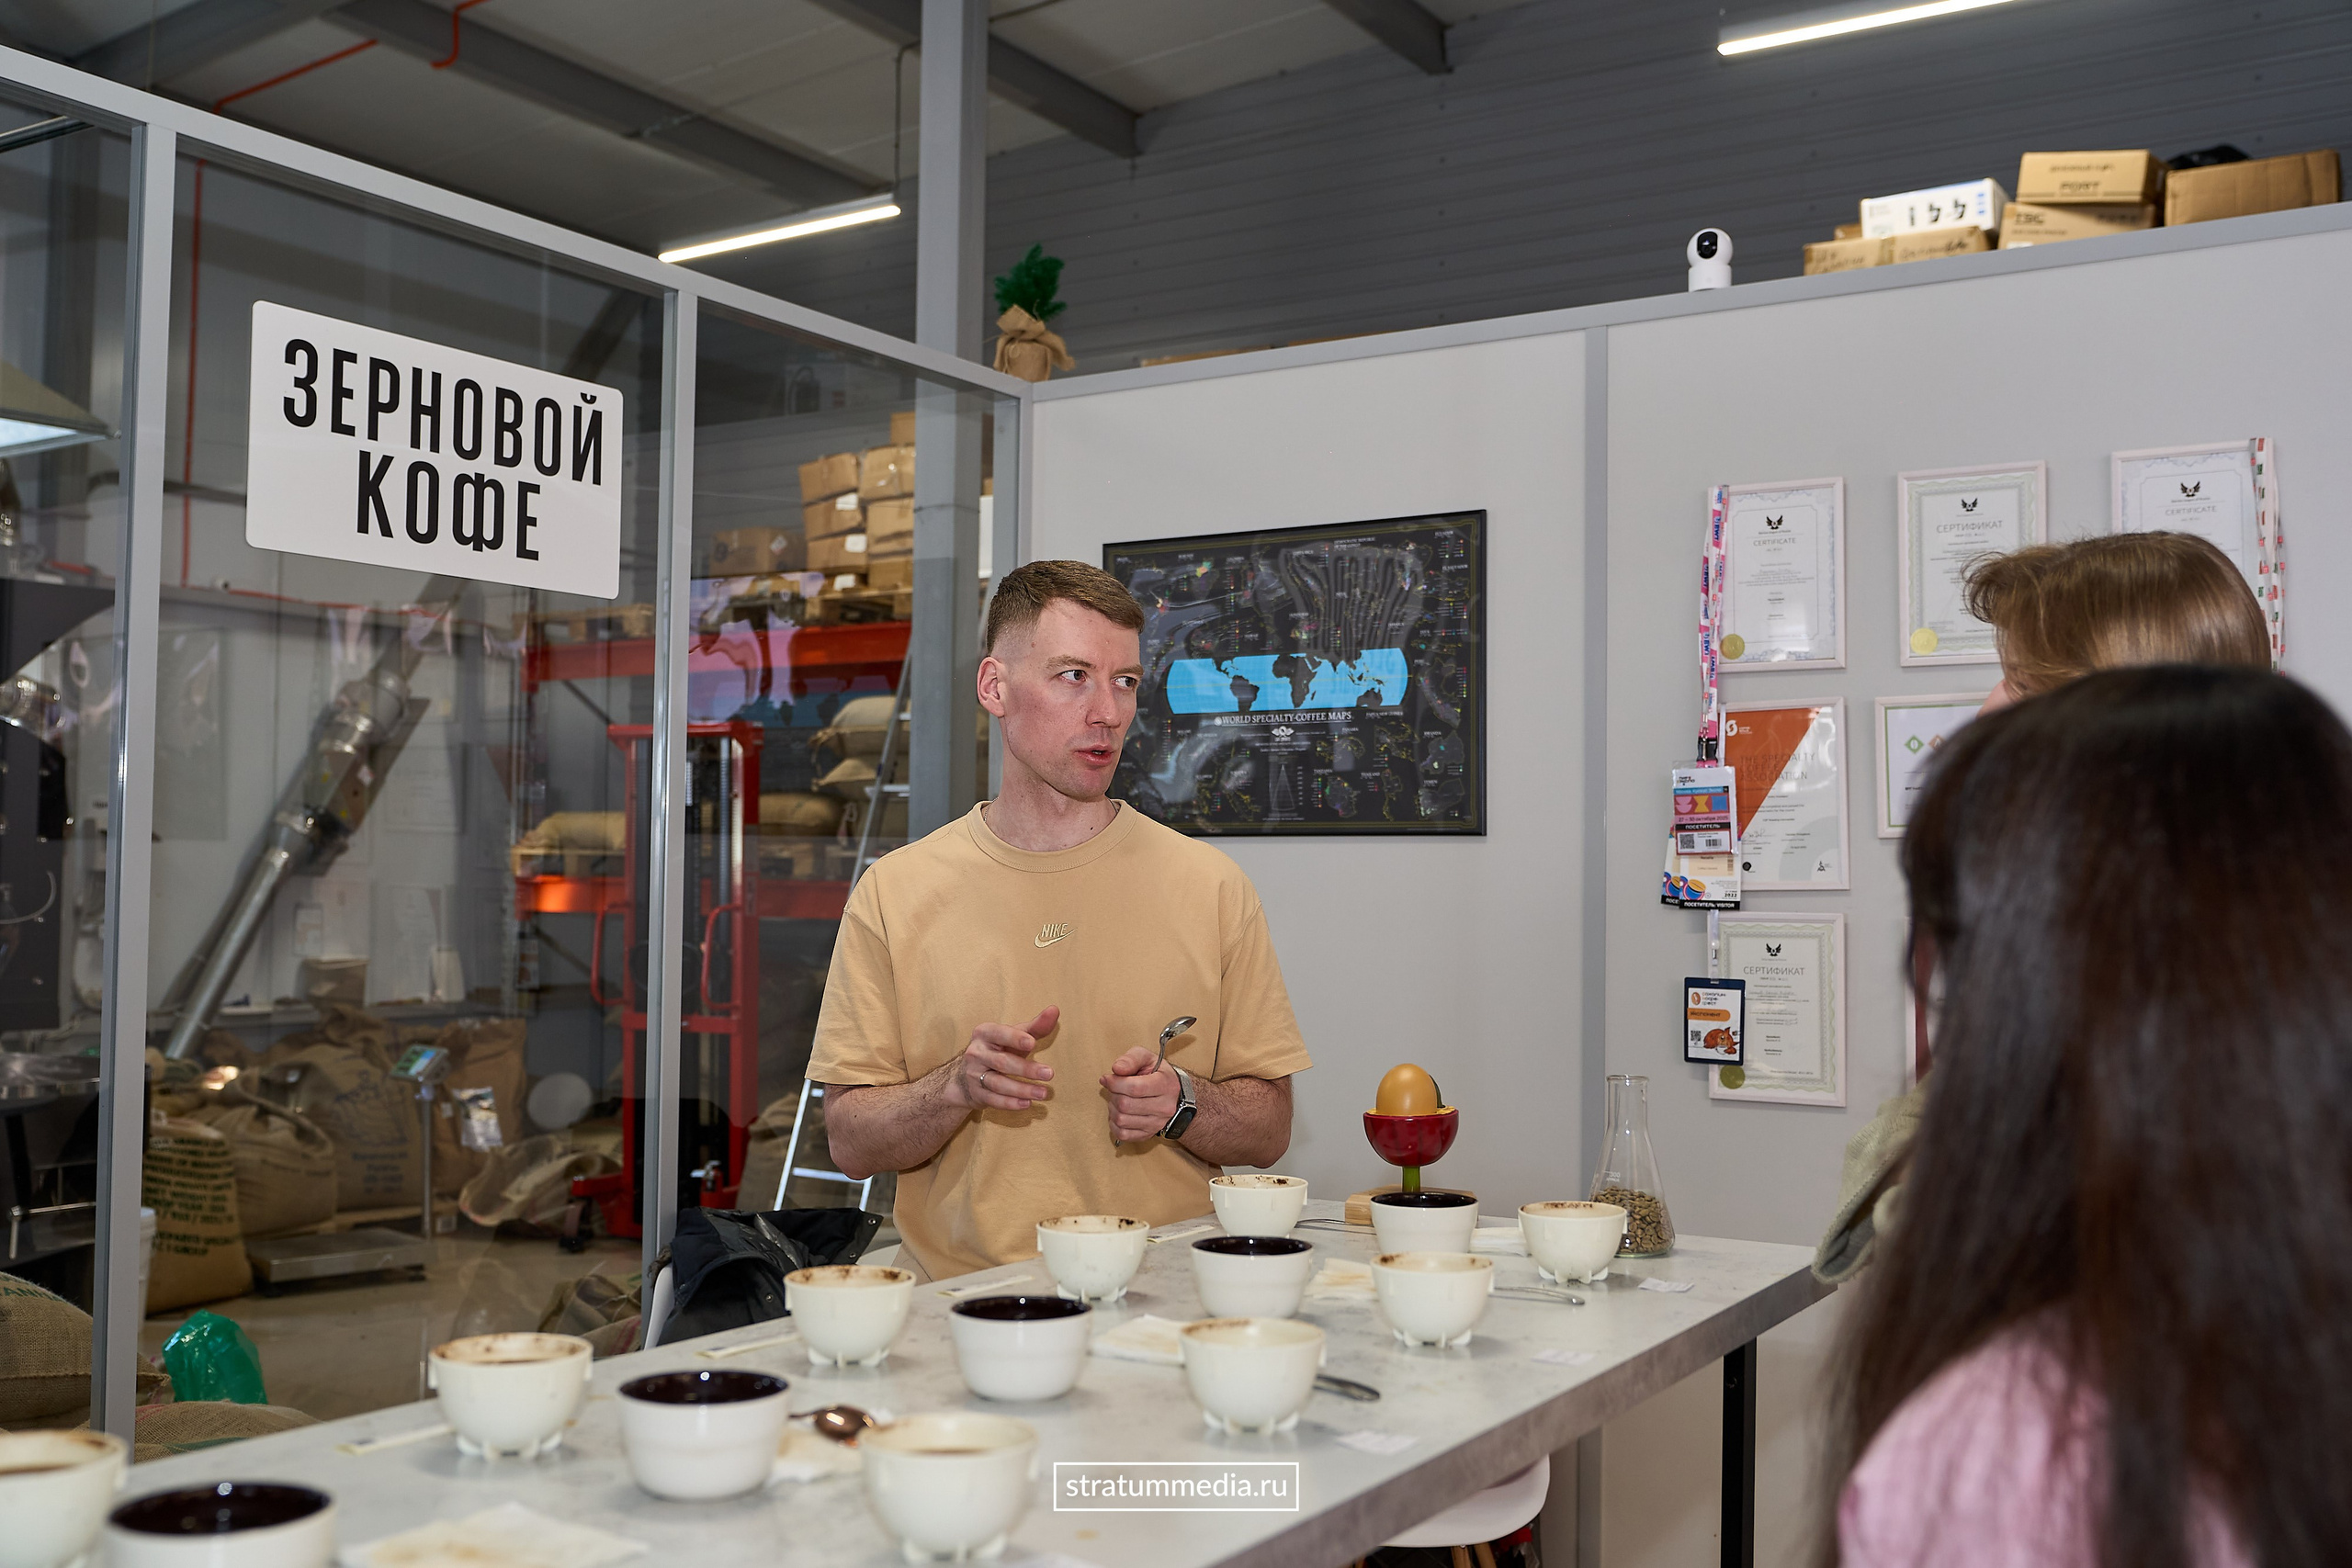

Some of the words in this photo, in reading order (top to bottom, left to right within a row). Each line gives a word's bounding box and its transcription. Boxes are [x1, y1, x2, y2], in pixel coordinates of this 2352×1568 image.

[283, 338, 603, 487] ЗЕРНОВОЙ
[356, 449, 541, 561] КОФЕ
[2165, 505, 2217, 516] CERTIFICATE
[1936, 520, 2003, 534] СЕРТИФИКАТ
[1753, 537, 1796, 547] CERTIFICATE
[1222, 716, 1250, 724] WORLD
[1252, 712, 1326, 723] SPECIALTY-COFFEE
[1328, 711, 1351, 720] MAPS
[1762, 753, 1815, 762] SPECIALTY
[1740, 763, 1779, 772] COFFEE
[1740, 772, 1807, 781] ASSOCIATION
[1041, 923, 1068, 937] NIKE
[1743, 966, 1804, 976] СЕРТИФИКАТ
